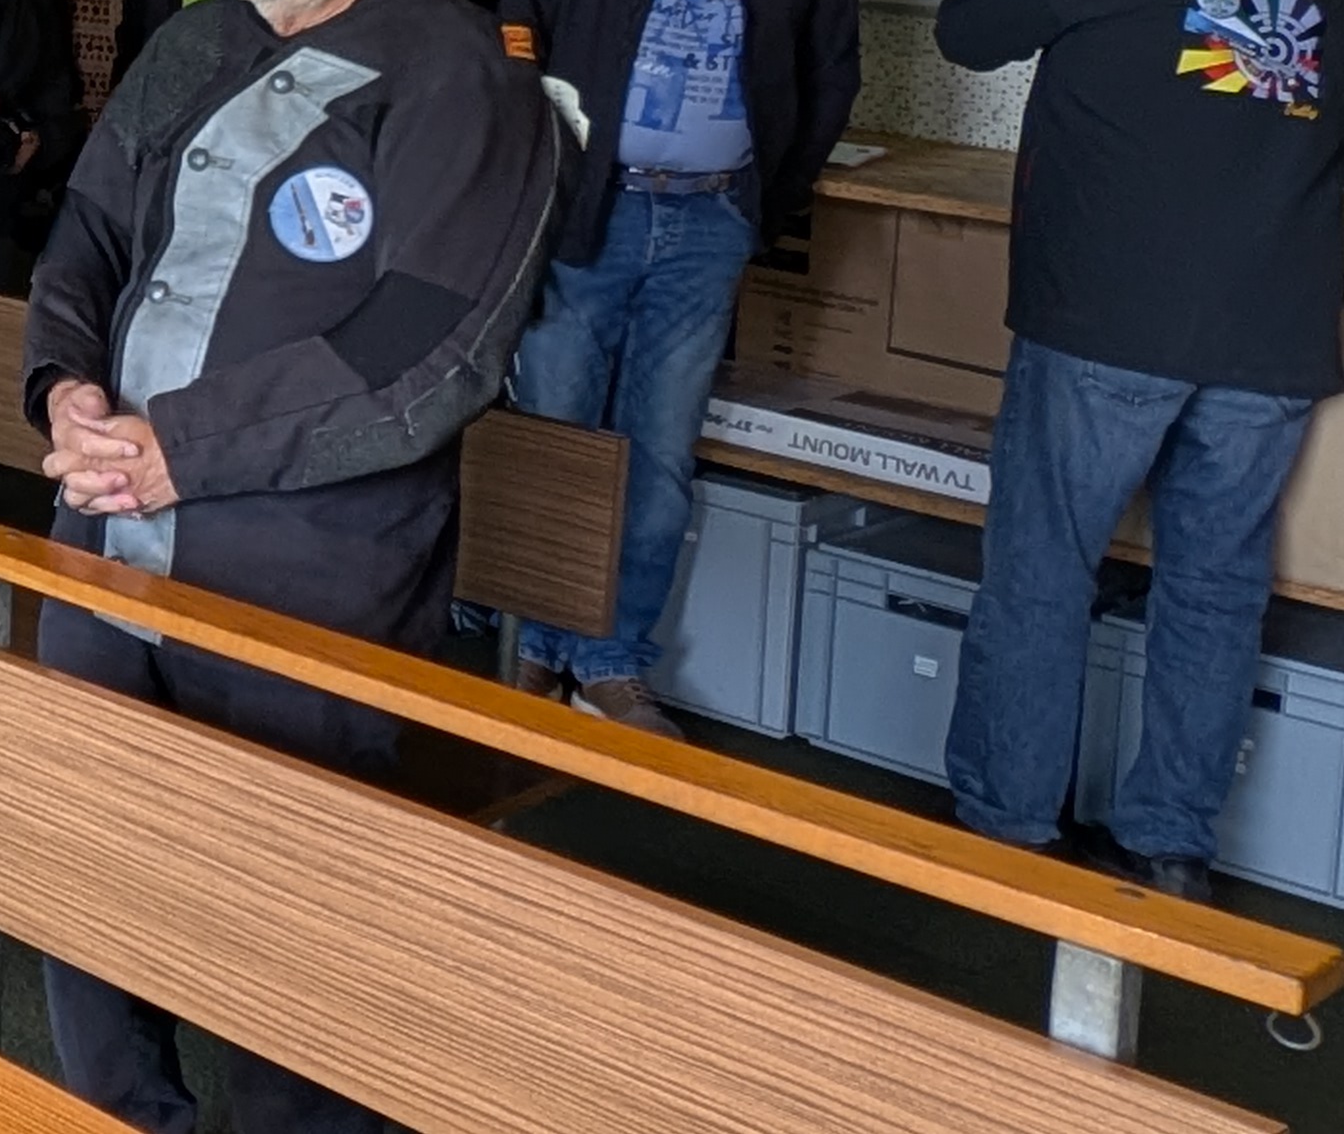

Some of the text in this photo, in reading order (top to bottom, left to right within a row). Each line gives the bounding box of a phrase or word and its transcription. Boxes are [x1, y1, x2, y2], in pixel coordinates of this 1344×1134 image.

[787, 432, 871, 466] MOUNT
[874, 451, 941, 486] WALL
[943, 471, 976, 492] TV
